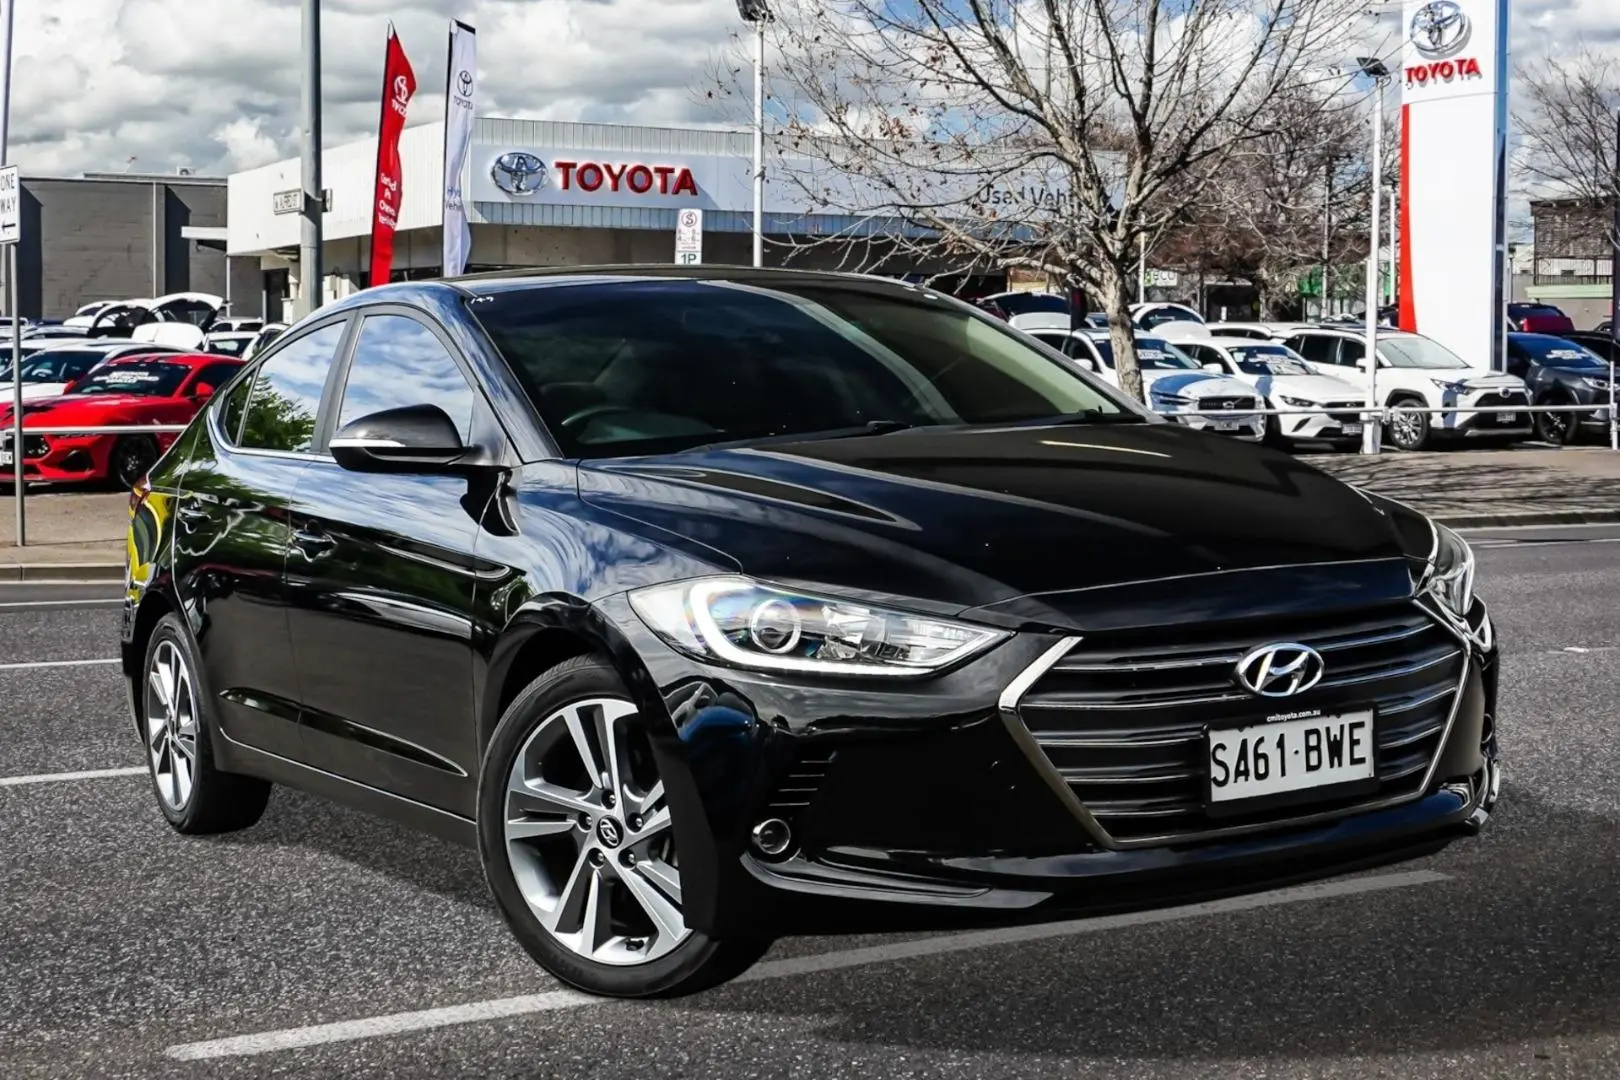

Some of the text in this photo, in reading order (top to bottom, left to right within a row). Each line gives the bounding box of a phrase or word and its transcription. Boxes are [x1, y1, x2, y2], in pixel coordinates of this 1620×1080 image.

[1404, 58, 1480, 83] TOYOTA
[0, 173, 15, 191] ONE
[555, 161, 698, 196] TOYOTA
[681, 253, 697, 264] 1P
